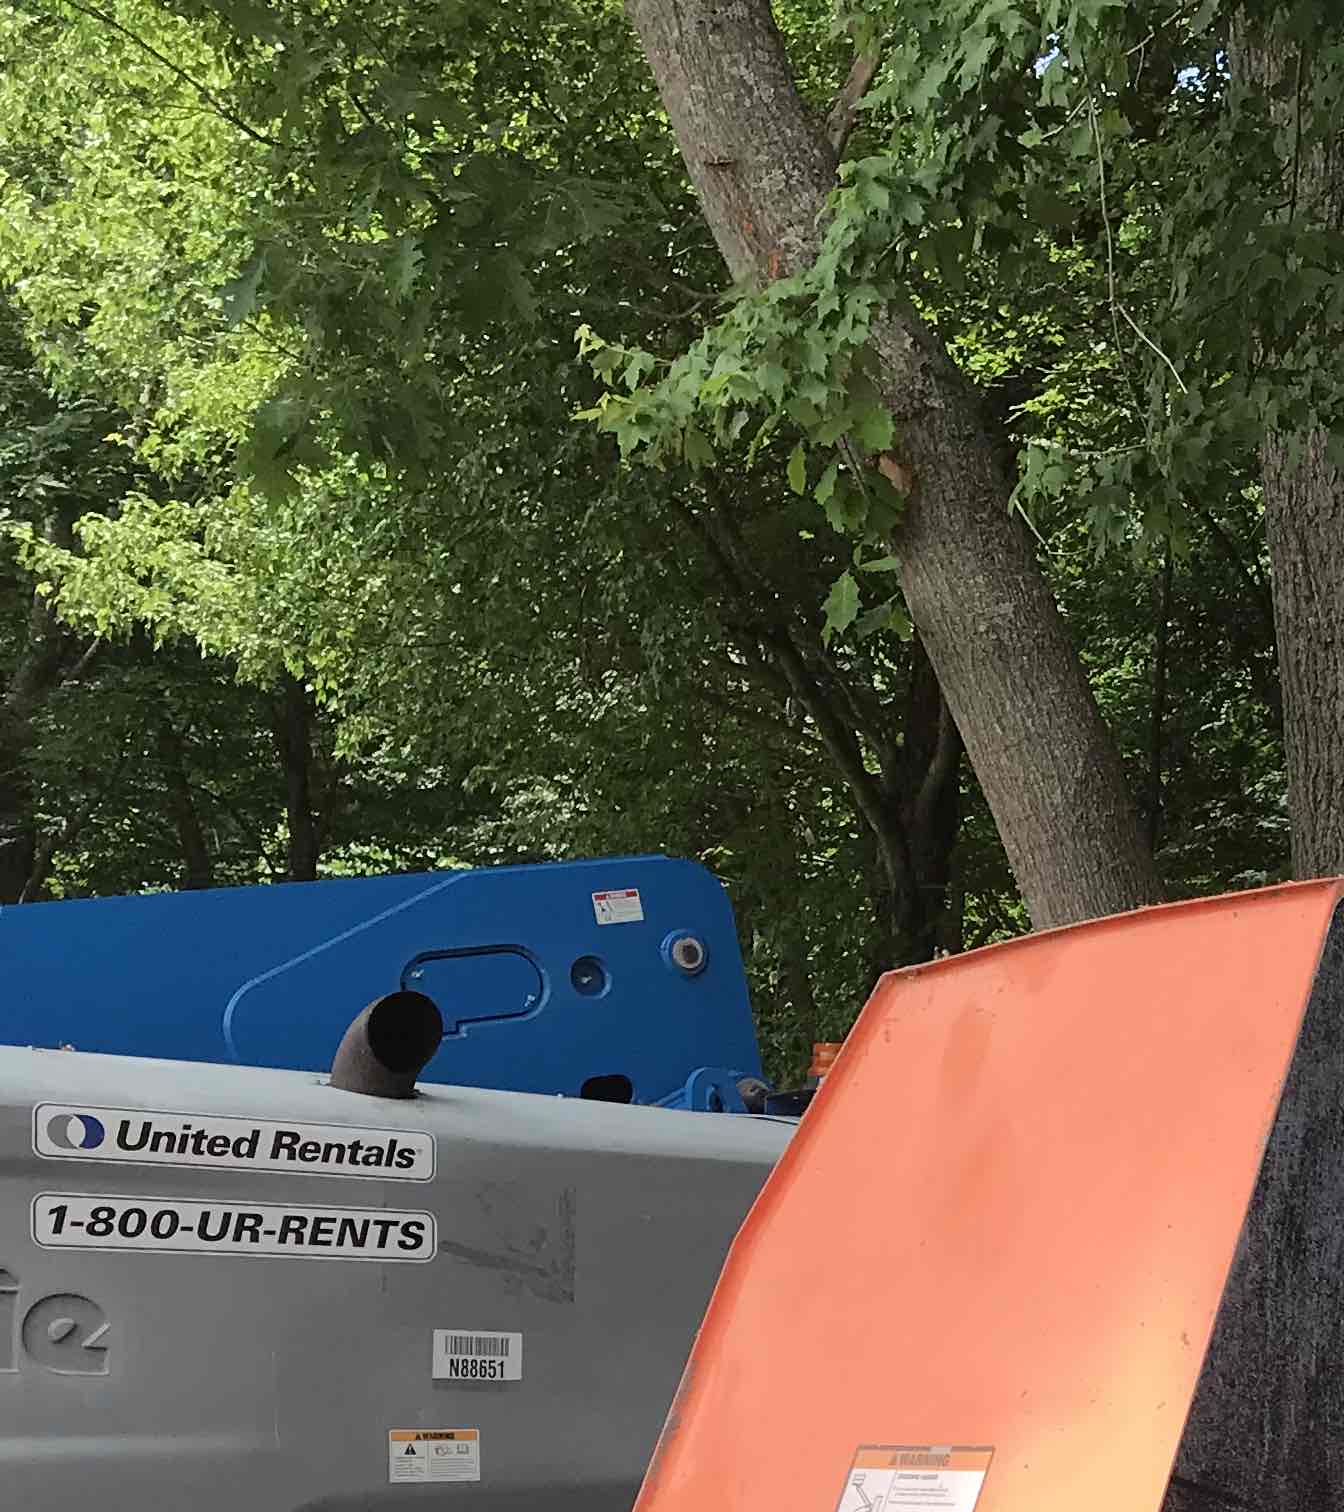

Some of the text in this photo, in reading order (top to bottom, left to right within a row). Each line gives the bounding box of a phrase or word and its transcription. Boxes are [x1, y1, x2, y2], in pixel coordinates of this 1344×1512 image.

[117, 1117, 416, 1171] United Rentals
[47, 1205, 426, 1251] 1-800-UR-RENTS
[450, 1358, 505, 1379] N88651
